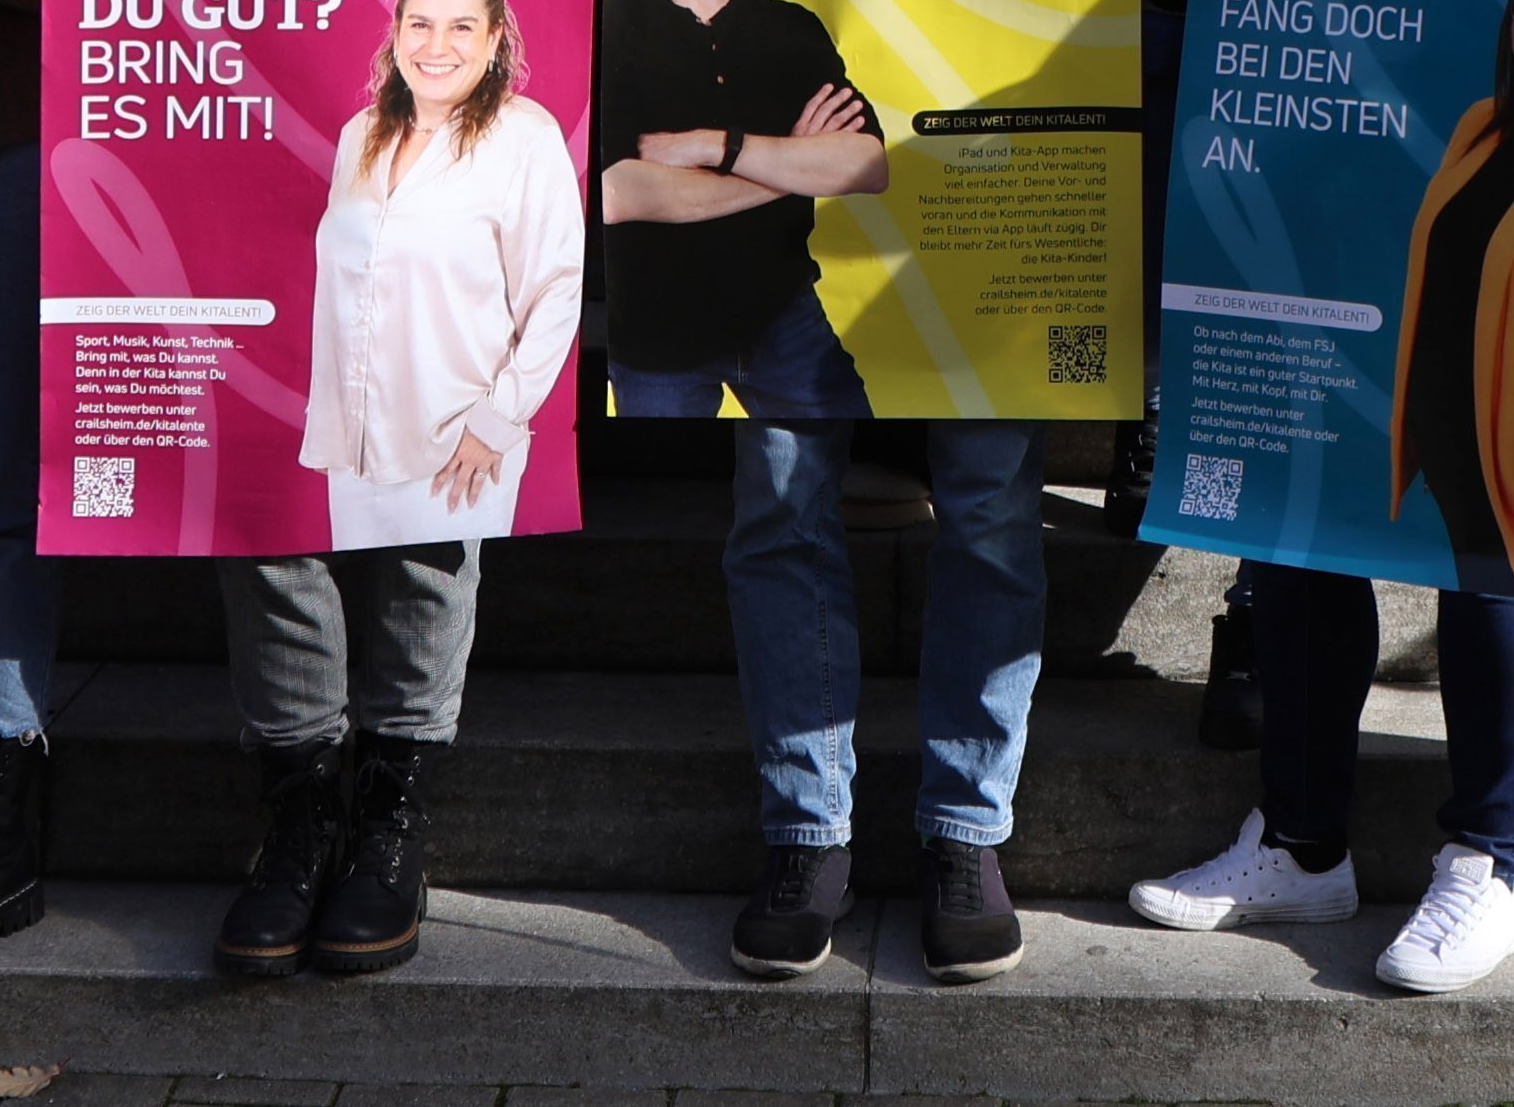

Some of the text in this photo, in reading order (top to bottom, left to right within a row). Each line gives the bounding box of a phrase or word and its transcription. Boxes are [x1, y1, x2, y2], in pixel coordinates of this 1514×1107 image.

[1324, 2, 1423, 42] DOCH
[81, 40, 243, 85] BRING
[1215, 41, 1352, 84] BEI DEN
[81, 95, 273, 140] ES MIT!
[924, 113, 1106, 129] ZEIG DER WELT DEIN KITALENT!
[1210, 88, 1407, 139] KLEINSTEN
[1202, 136, 1260, 173] AN.
[76, 305, 261, 317] ZEIG DER WELT DEIN KITALENT!
[1194, 293, 1369, 324] ZEIG DER WELT DEIN KITALENT!
[75, 334, 234, 349] Sport, Musik, Kunst, Technik
[1193, 325, 1335, 353] Ob nach dem Abi, dem FSJ
[75, 350, 219, 364] Bring mit, was Du kannst.
[1193, 343, 1332, 369] oder einem anderen Beruf
[75, 366, 226, 380] Denn in der Kita kannst Du
[1192, 360, 1357, 389] die Kita ist ein guter Startpunkt.
[75, 382, 205, 395] sein, was Du möchtest.
[1192, 375, 1328, 402] Mit Herz, mit Kopf, mit Dir.
[75, 402, 197, 415] Jetzt bewerben unter
[1191, 396, 1305, 421] Jetzt bewerben unter
[74, 433, 210, 447] oder über den QR-Code.
[1189, 430, 1289, 453] über den QR-Code.
[1314, 430, 1339, 442] oder
